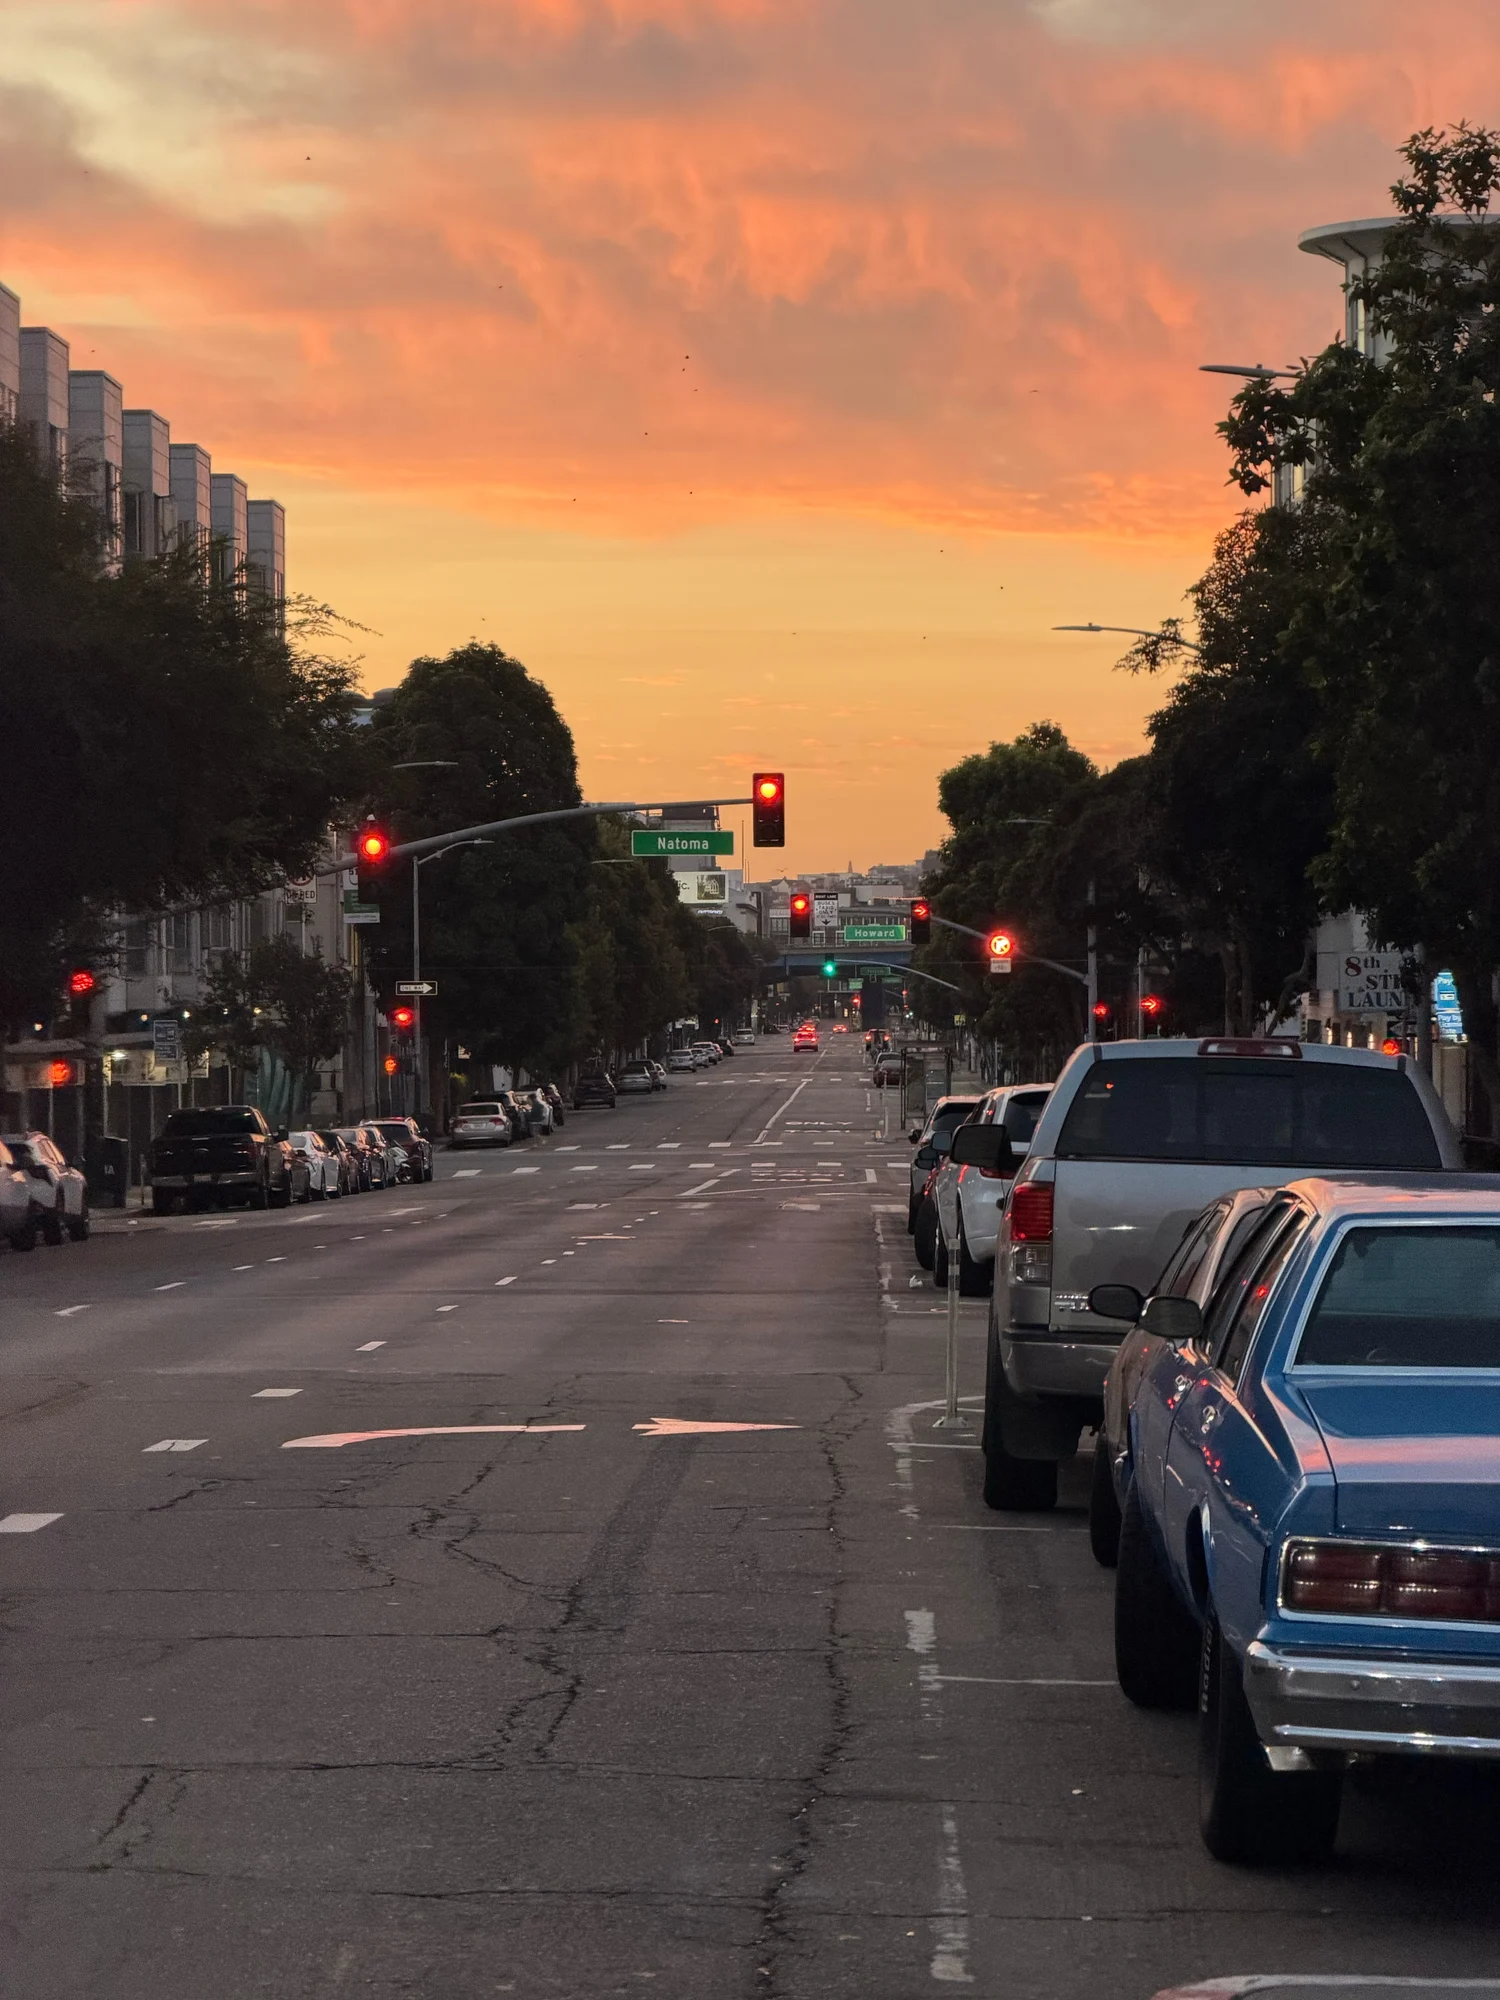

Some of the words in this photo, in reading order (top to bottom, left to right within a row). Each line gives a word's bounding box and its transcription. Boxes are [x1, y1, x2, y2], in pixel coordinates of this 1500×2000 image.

[657, 837, 709, 850] Natoma
[854, 929, 895, 937] Howard
[1345, 956, 1380, 977] 8th
